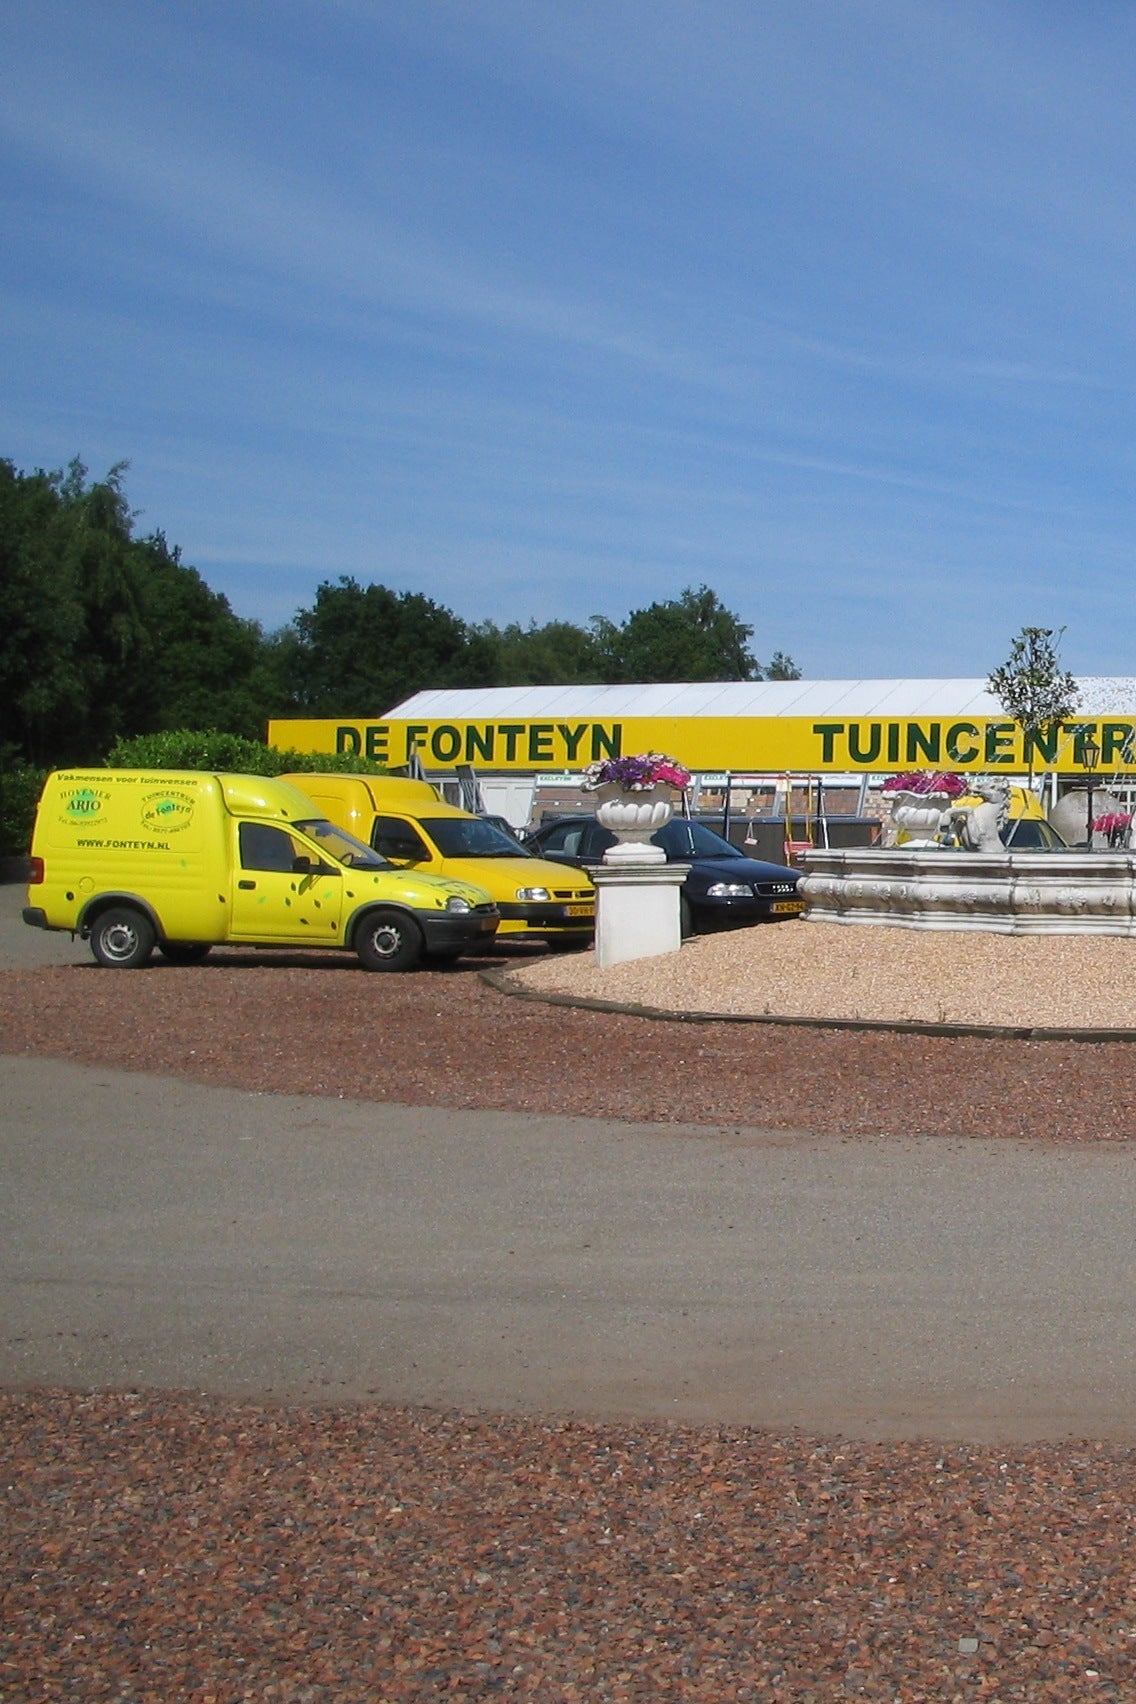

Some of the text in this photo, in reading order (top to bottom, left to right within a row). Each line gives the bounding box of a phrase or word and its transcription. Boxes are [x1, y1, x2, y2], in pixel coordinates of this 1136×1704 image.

[336, 724, 622, 762] DE FONTEYN
[57, 773, 113, 783] Vakmensen
[67, 799, 101, 813] ARJO
[77, 839, 171, 851] WWW.FONTEYN.NL
